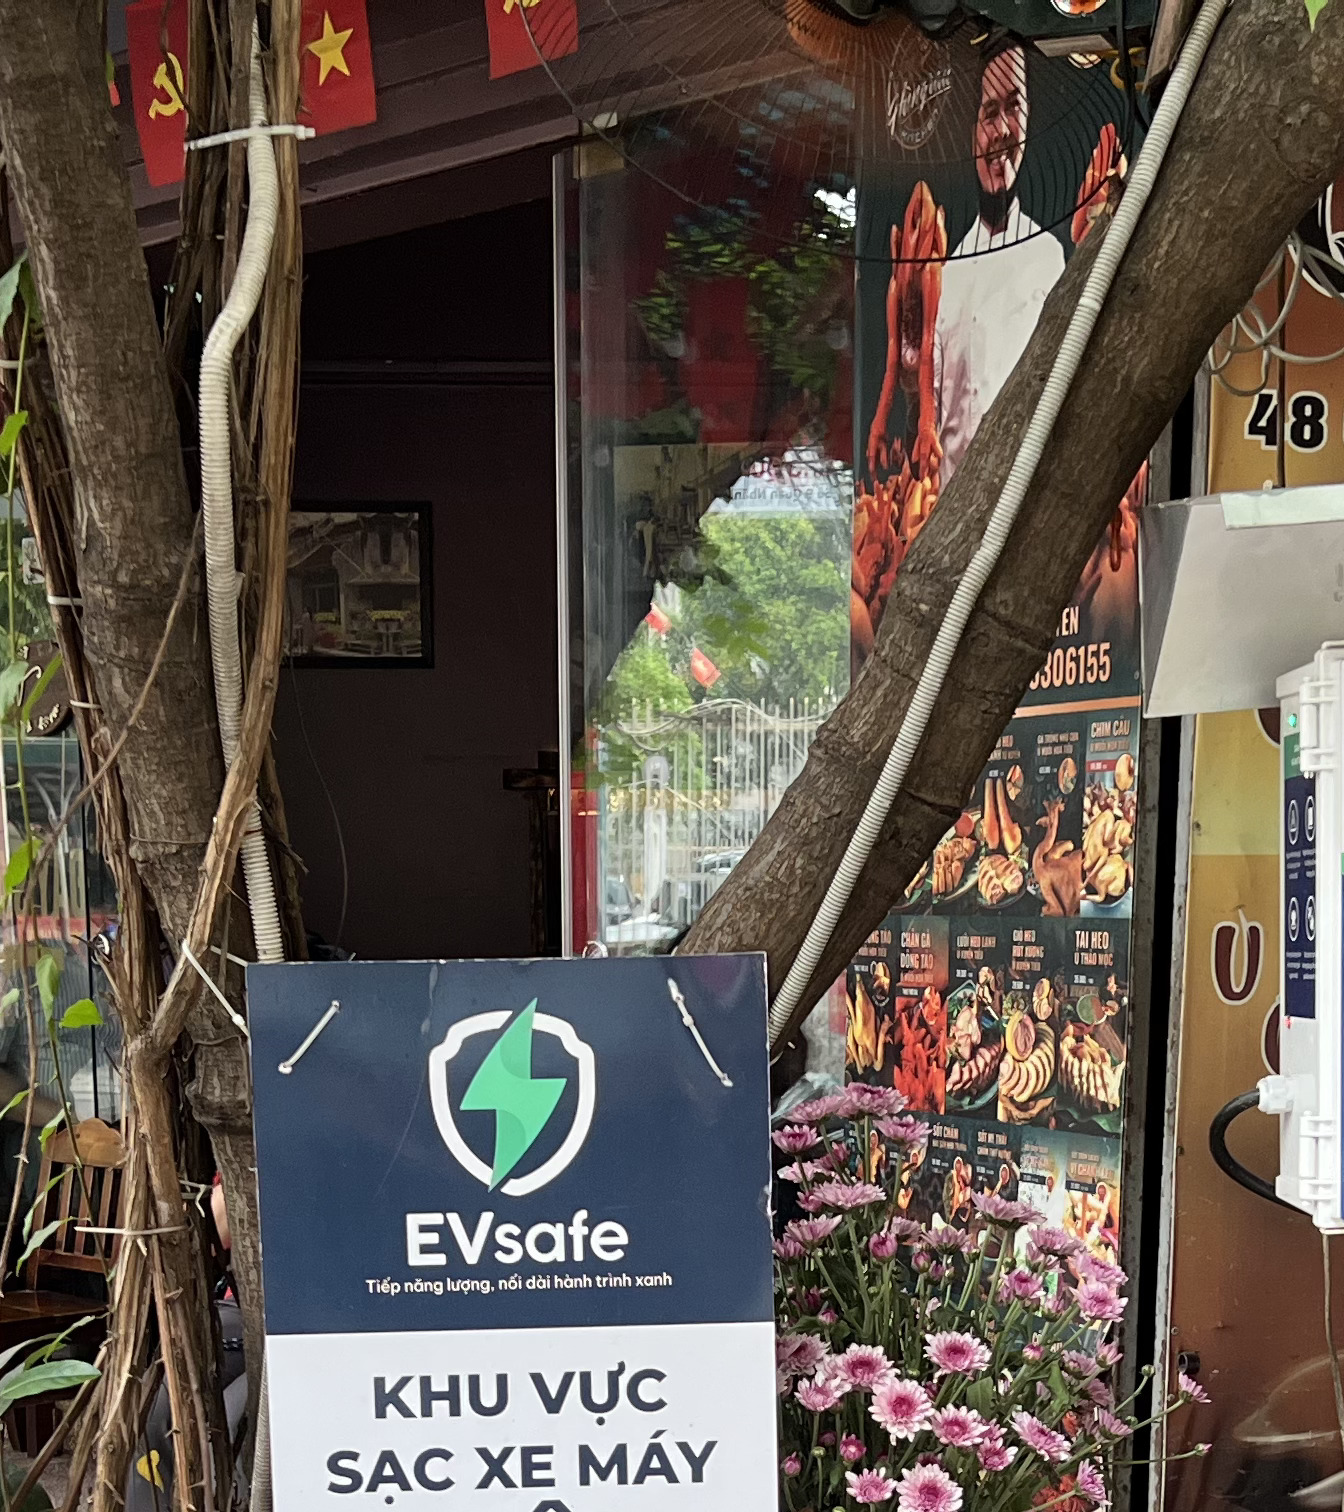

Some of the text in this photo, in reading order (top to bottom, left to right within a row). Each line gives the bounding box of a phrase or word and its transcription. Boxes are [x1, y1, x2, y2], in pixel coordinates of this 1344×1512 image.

[1244, 388, 1328, 454] 48
[1090, 719, 1112, 739] CHIM
[1075, 930, 1110, 951] TAI HEO
[405, 1208, 630, 1267] EVsafe
[365, 1271, 673, 1296] Tiếp năng lượng, nối dài hành trình xanh
[372, 1361, 669, 1427] KHU VỰC
[325, 1429, 718, 1505] SẠC XE MÁY
